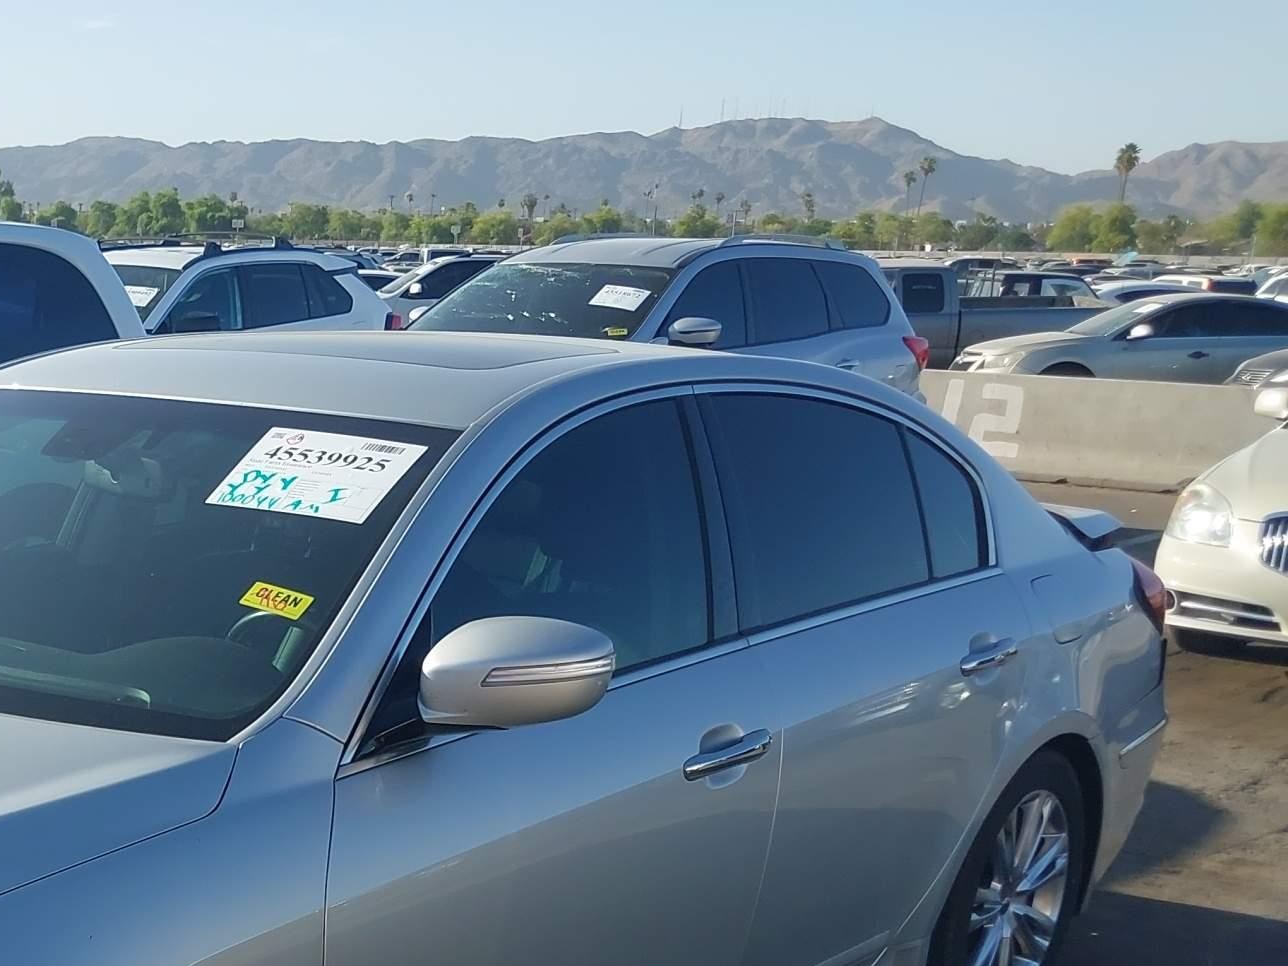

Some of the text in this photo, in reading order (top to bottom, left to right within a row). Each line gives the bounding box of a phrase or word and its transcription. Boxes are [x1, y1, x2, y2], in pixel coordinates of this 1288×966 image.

[941, 379, 1024, 458] 12
[264, 445, 392, 473] 45539925
[255, 587, 303, 608] CLEAN
